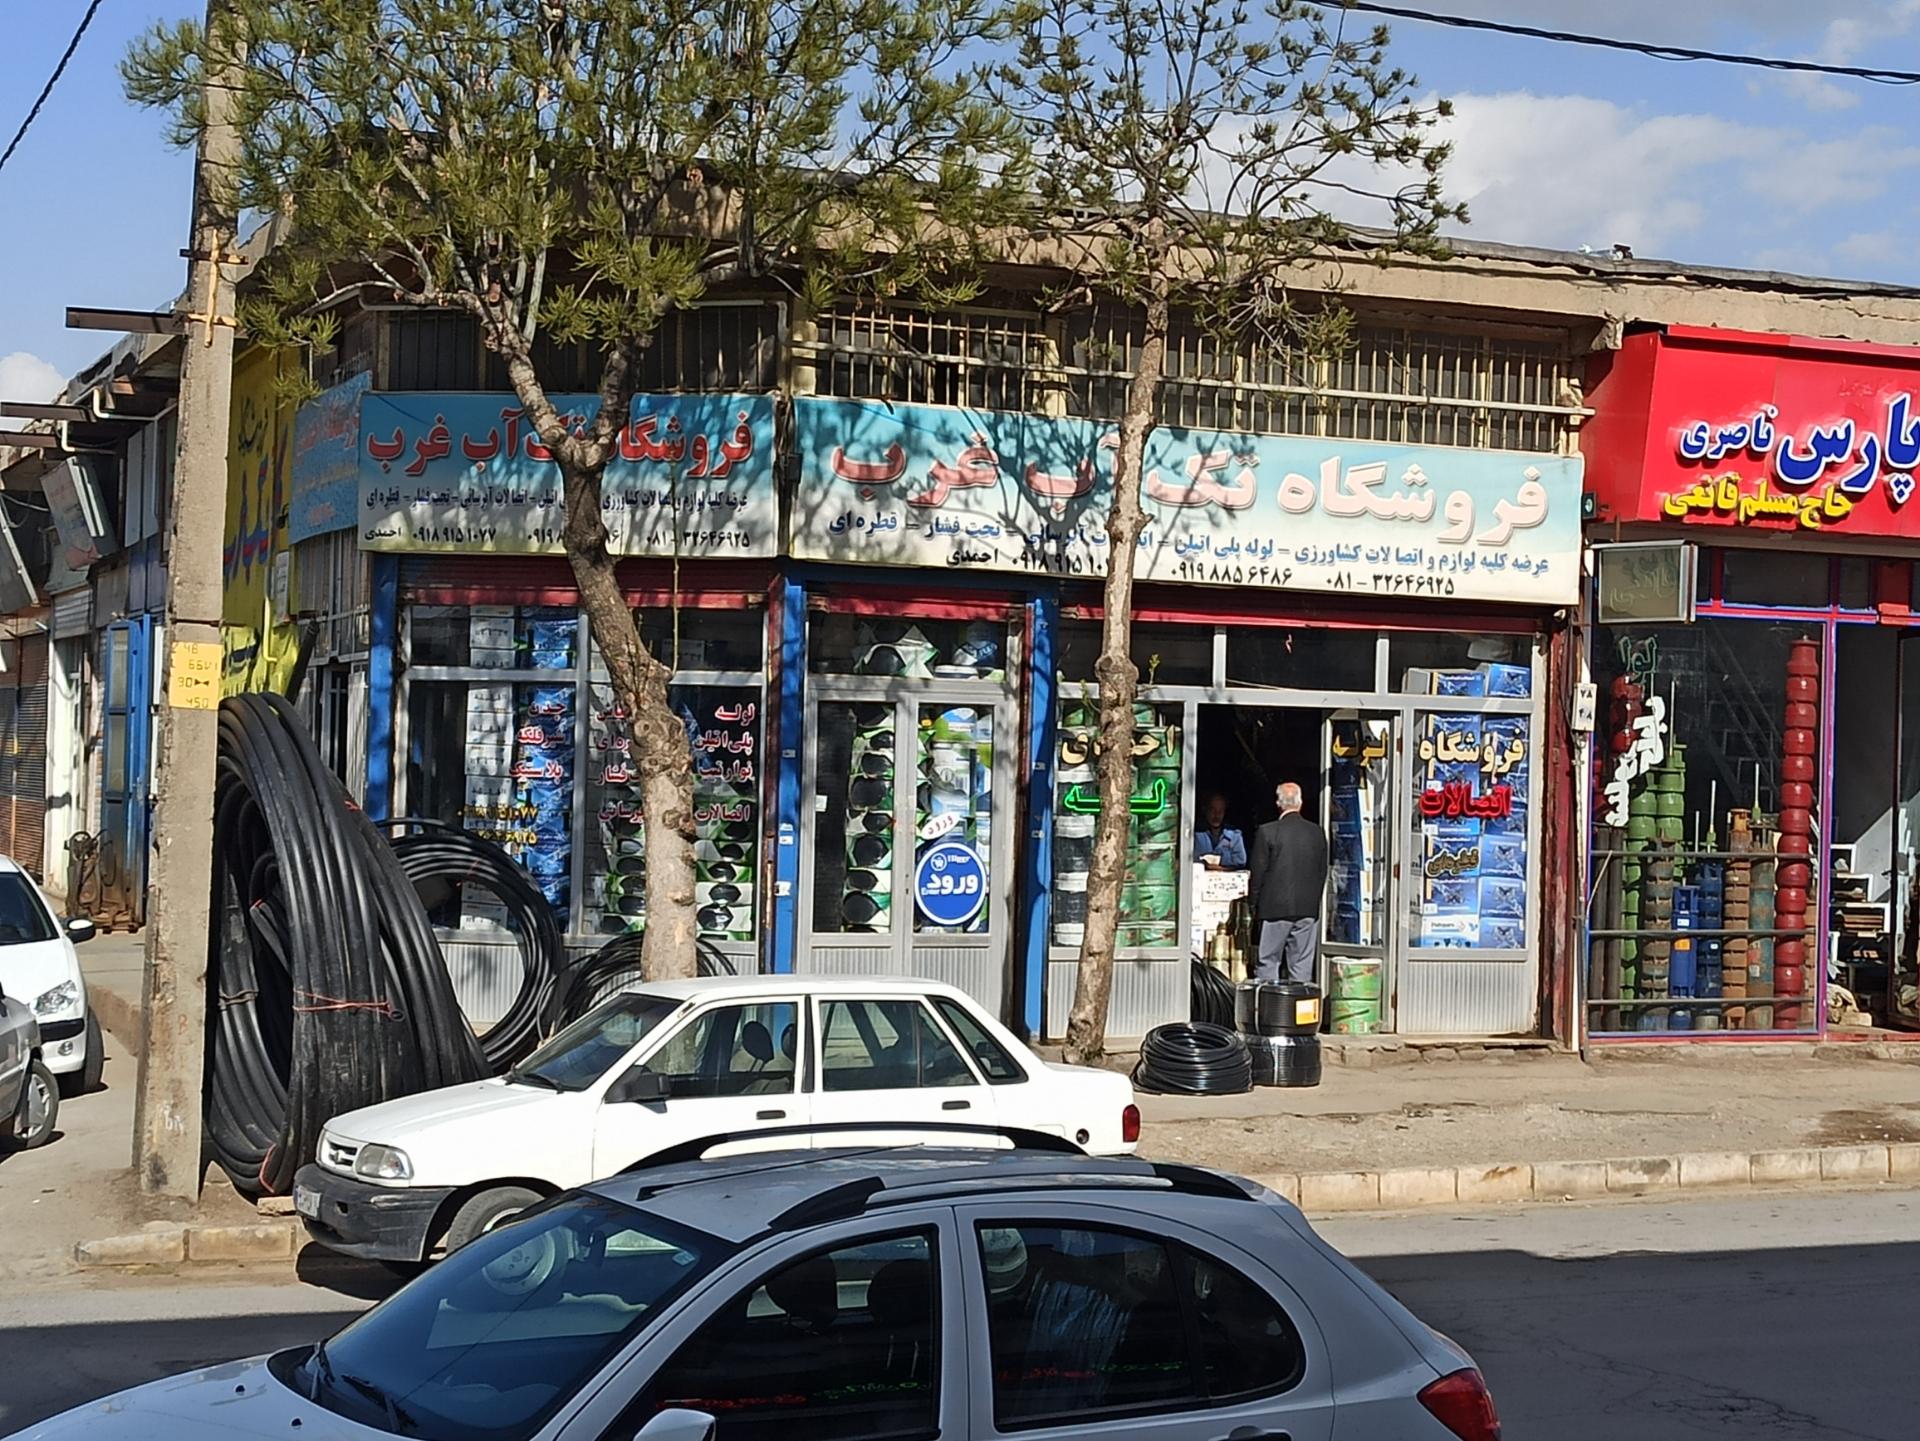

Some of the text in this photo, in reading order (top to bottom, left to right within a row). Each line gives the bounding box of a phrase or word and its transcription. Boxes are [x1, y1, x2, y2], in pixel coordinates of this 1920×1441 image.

[367, 412, 454, 477] غرب
[462, 405, 526, 475] آب
[1681, 393, 1920, 504] پارس ناصری
[831, 430, 999, 508] غرب
[1147, 449, 1261, 511] تک
[1277, 456, 1549, 546] فروشگاه
[1738, 479, 1799, 522] مسلم
[1799, 484, 1853, 529] حاج
[364, 526, 402, 541] احمدی
[924, 516, 961, 540] فشار
[946, 548, 999, 567] احمدی
[1214, 536, 1241, 560] پلی
[1245, 538, 1274, 562] لوله
[1295, 542, 1362, 566] کشاورزی
[1427, 554, 1436, 572] و
[1438, 550, 1476, 572] لوازم
[1480, 552, 1508, 574] کلیه
[1511, 554, 1550, 578] عرضه
[1061, 724, 1176, 765] احی
[1419, 728, 1525, 774] فروشگاه
[1419, 780, 1514, 818] اتصالات
